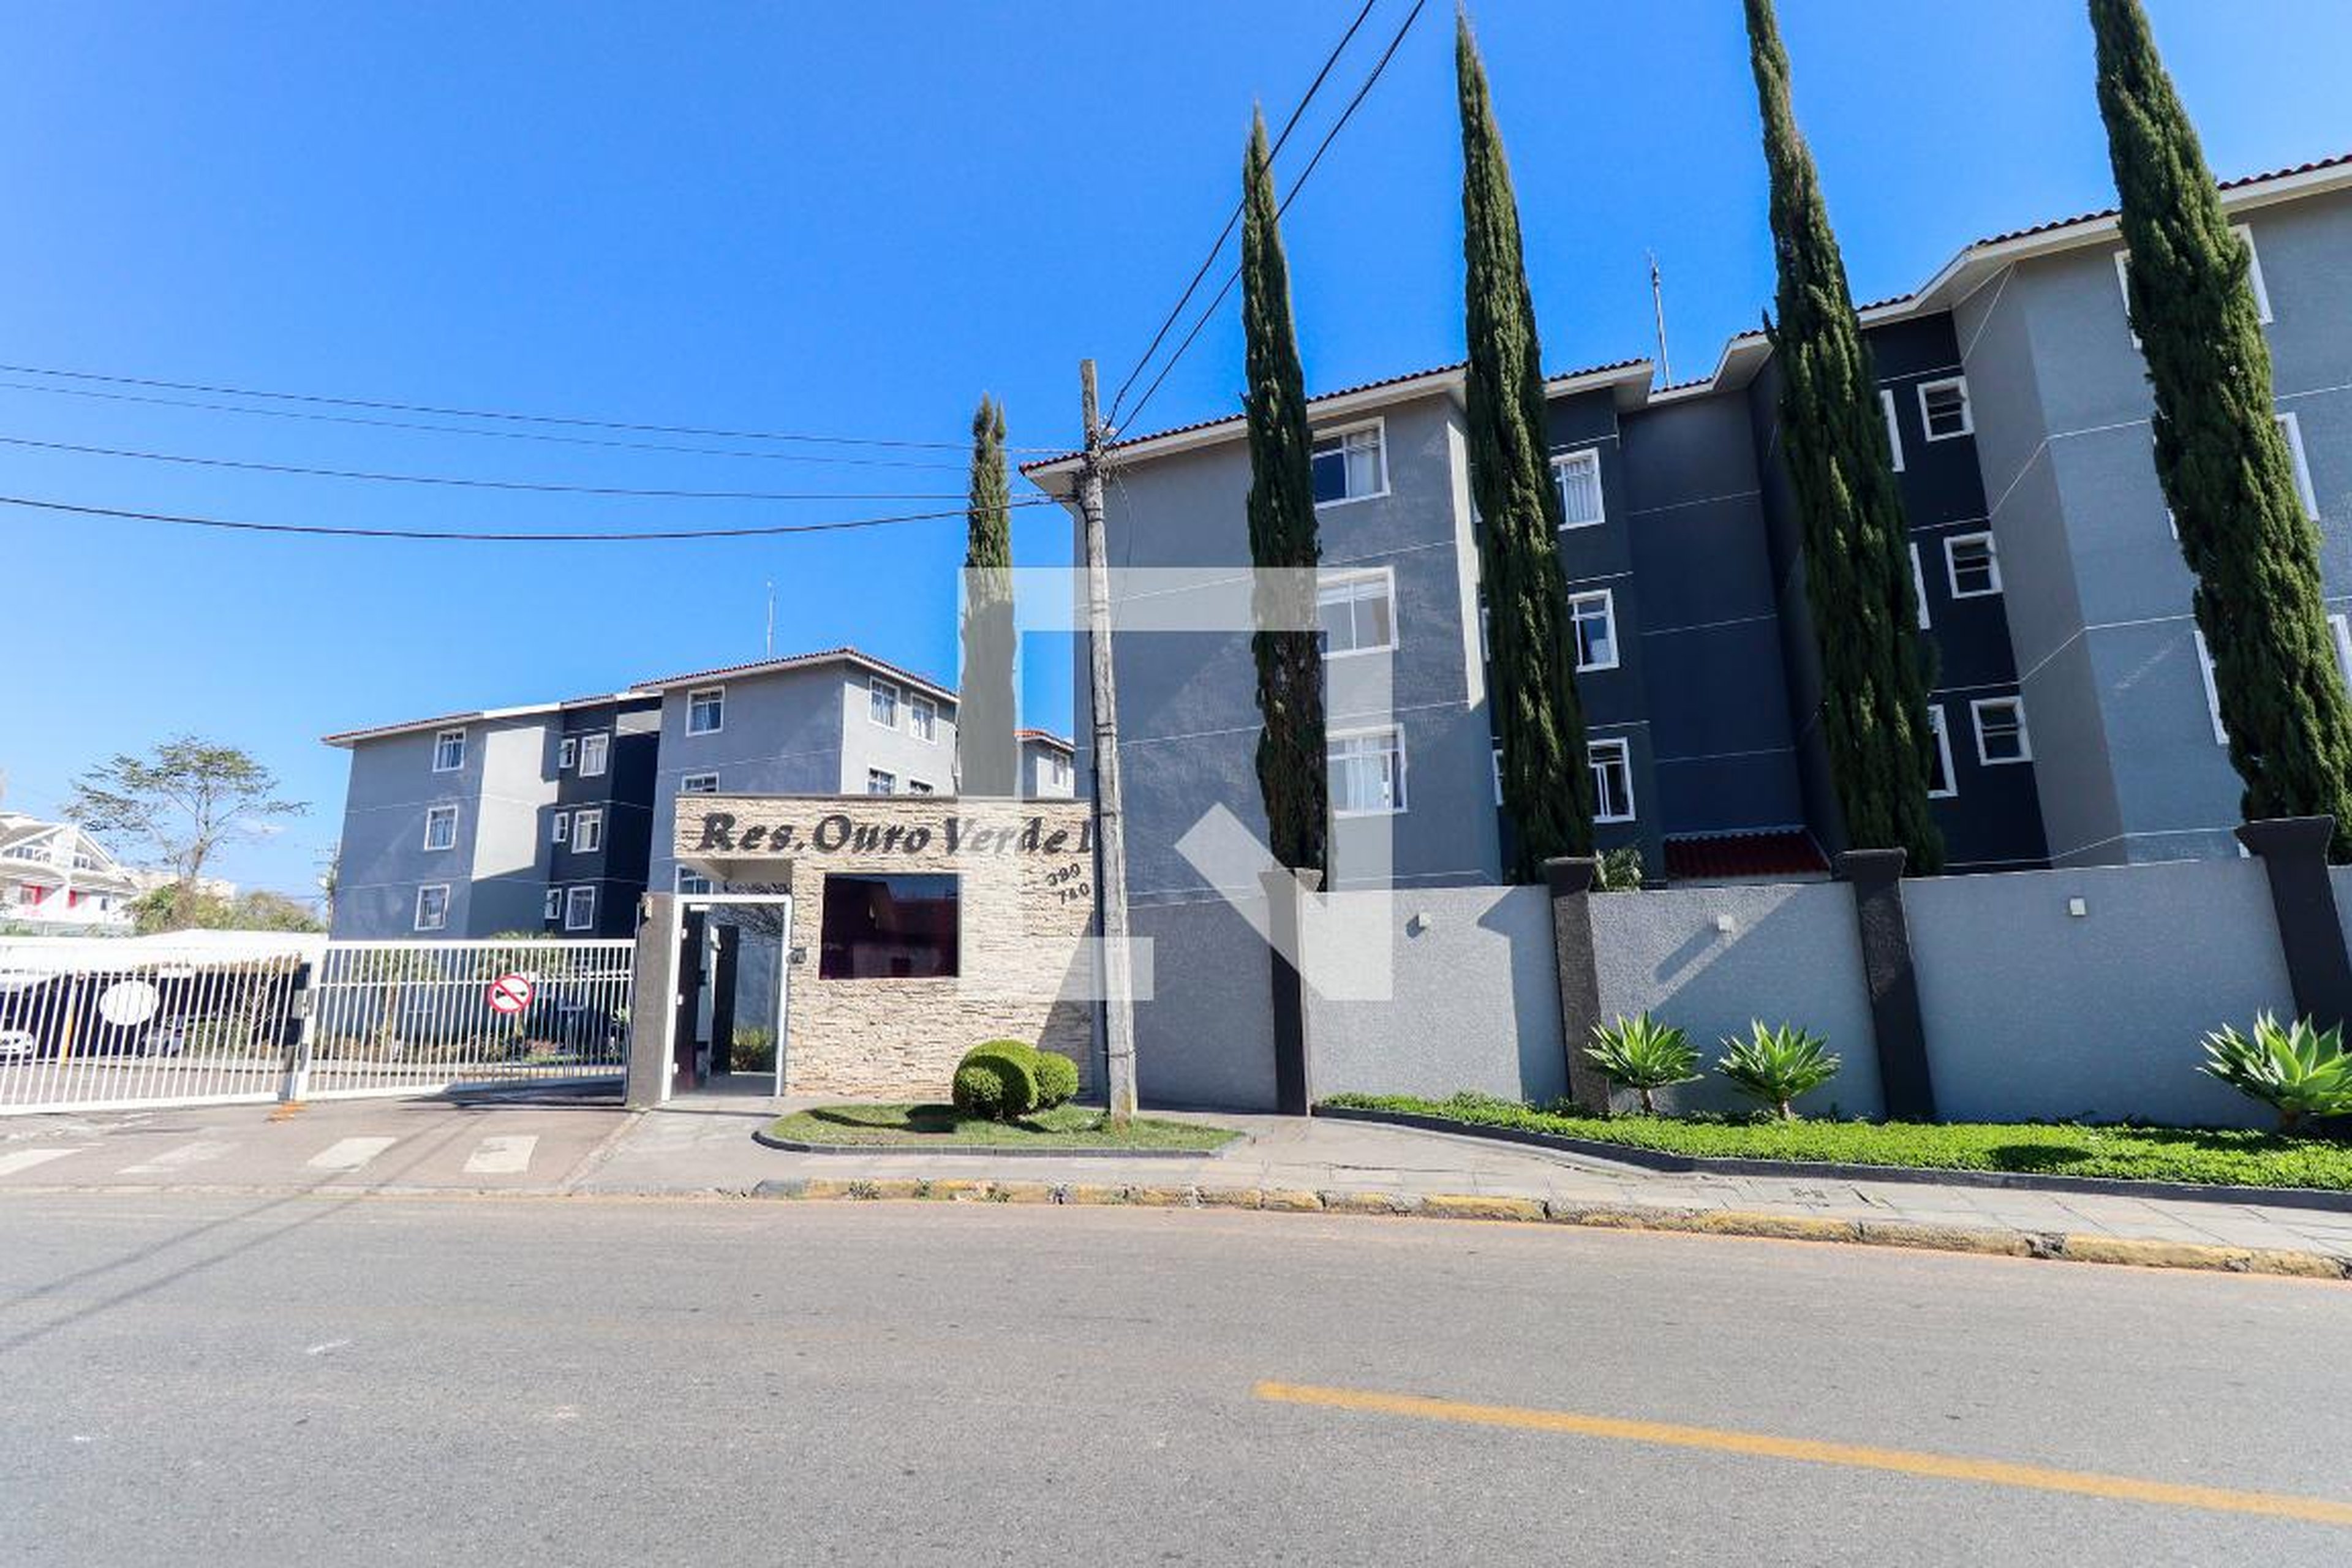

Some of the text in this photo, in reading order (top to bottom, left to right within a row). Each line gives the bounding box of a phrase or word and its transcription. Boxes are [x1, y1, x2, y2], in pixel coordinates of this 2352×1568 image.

[696, 812, 804, 851] Res.
[813, 814, 932, 854] Ouro
[945, 816, 1068, 856] Verde
